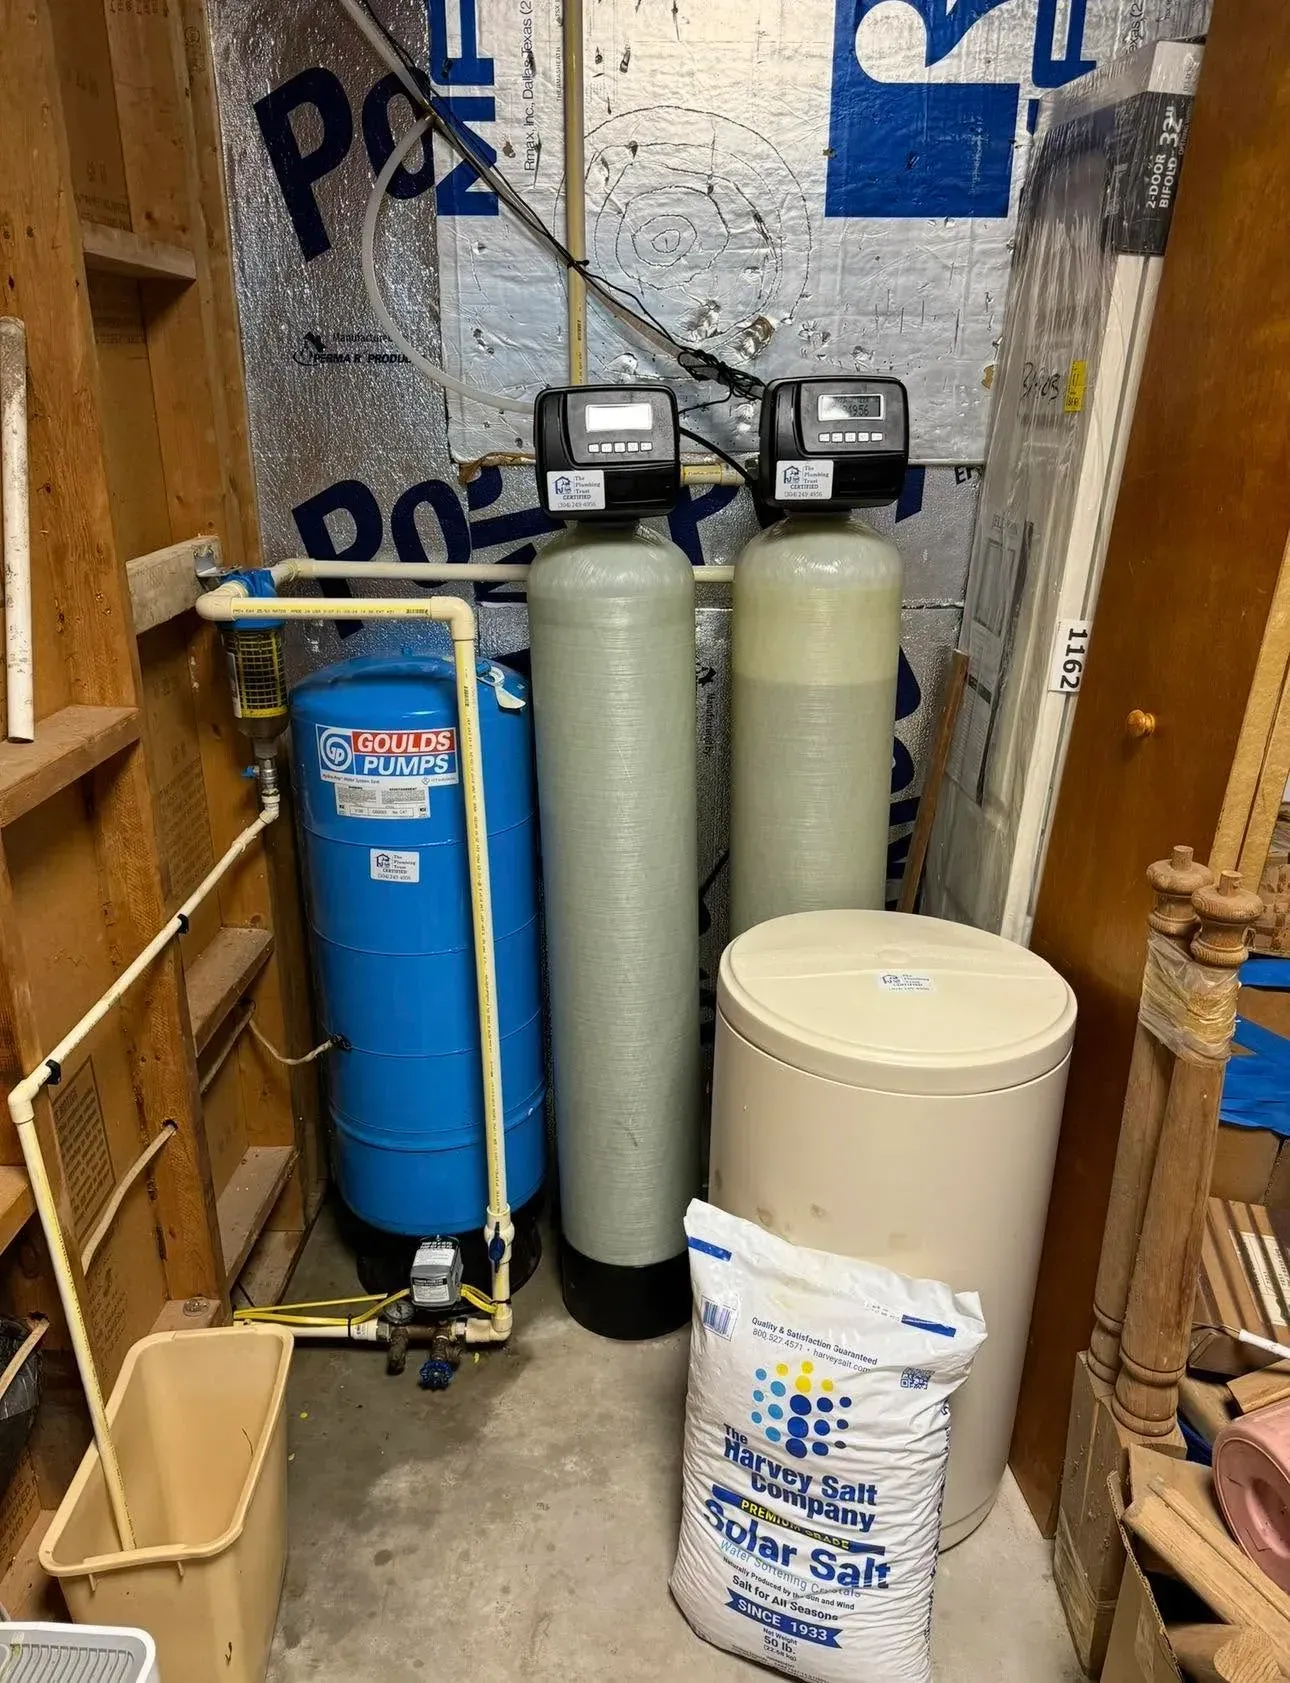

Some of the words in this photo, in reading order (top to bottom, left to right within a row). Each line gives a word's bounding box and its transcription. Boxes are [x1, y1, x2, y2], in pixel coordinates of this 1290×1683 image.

[519, 18, 533, 56] Texas
[1146, 153, 1167, 209] 2-DOOR
[1159, 156, 1178, 208] BIFOLD
[1059, 627, 1089, 690] 1162
[357, 731, 451, 753] GOULDS
[363, 754, 449, 776] PUMPS
[751, 1317, 778, 1333] Quality
[778, 1326, 786, 1335] &
[786, 1327, 832, 1350] Satisfaction
[833, 1343, 879, 1366] Guaranteed
[813, 1348, 871, 1374] harveysalt.com
[723, 1422, 748, 1445] The
[723, 1437, 814, 1495] Harvey
[821, 1475, 878, 1507] Salt
[740, 1499, 800, 1531] PREMIUM
[804, 1529, 850, 1550] GRADE
[750, 1471, 876, 1533] Company
[703, 1498, 798, 1568] Solar
[809, 1548, 892, 1589] Salt
[720, 1539, 751, 1564] Water
[753, 1554, 808, 1591] Softening
[722, 1556, 750, 1577] Naturally
[750, 1572, 782, 1591] Produced
[782, 1585, 792, 1597] by
[821, 1597, 835, 1606] and
[836, 1600, 855, 1611] Wind
[731, 1574, 753, 1594] Salt
[753, 1584, 770, 1600] for
[771, 1591, 788, 1608] All
[789, 1600, 839, 1622] Seasons
[737, 1598, 782, 1627] SINCE
[790, 1620, 828, 1641] 1933
[763, 1627, 776, 1637] Net
[776, 1631, 798, 1646] Weight
[763, 1636, 780, 1648] 50
[780, 1638, 797, 1655] lb.
